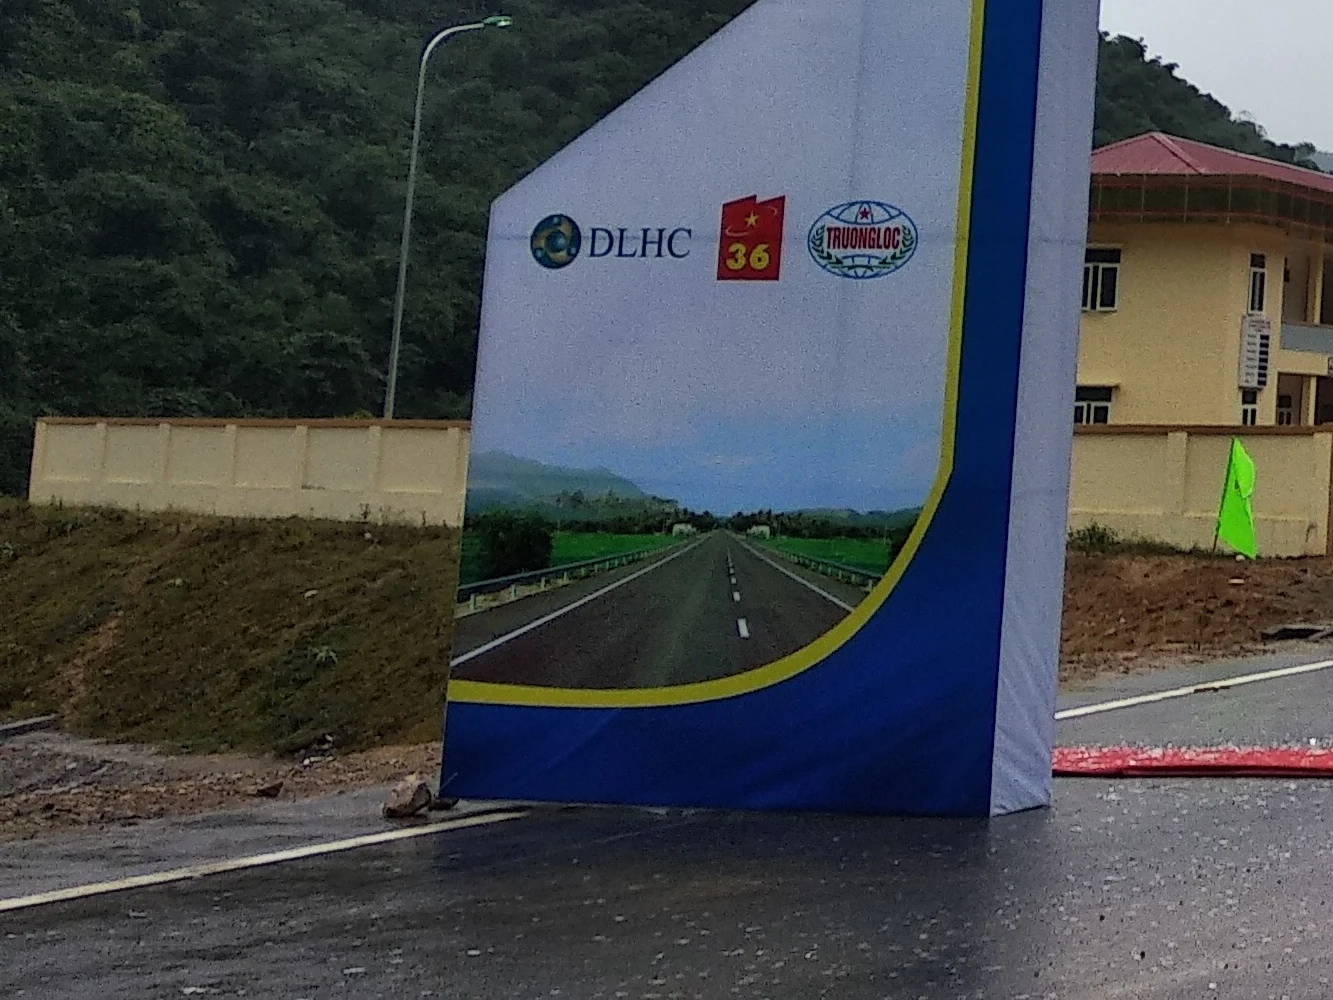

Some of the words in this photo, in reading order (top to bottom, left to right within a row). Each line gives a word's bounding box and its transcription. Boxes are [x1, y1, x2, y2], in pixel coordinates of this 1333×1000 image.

[588, 227, 693, 259] DLHC
[825, 223, 902, 251] TRUONGLOC
[724, 241, 771, 272] 36
